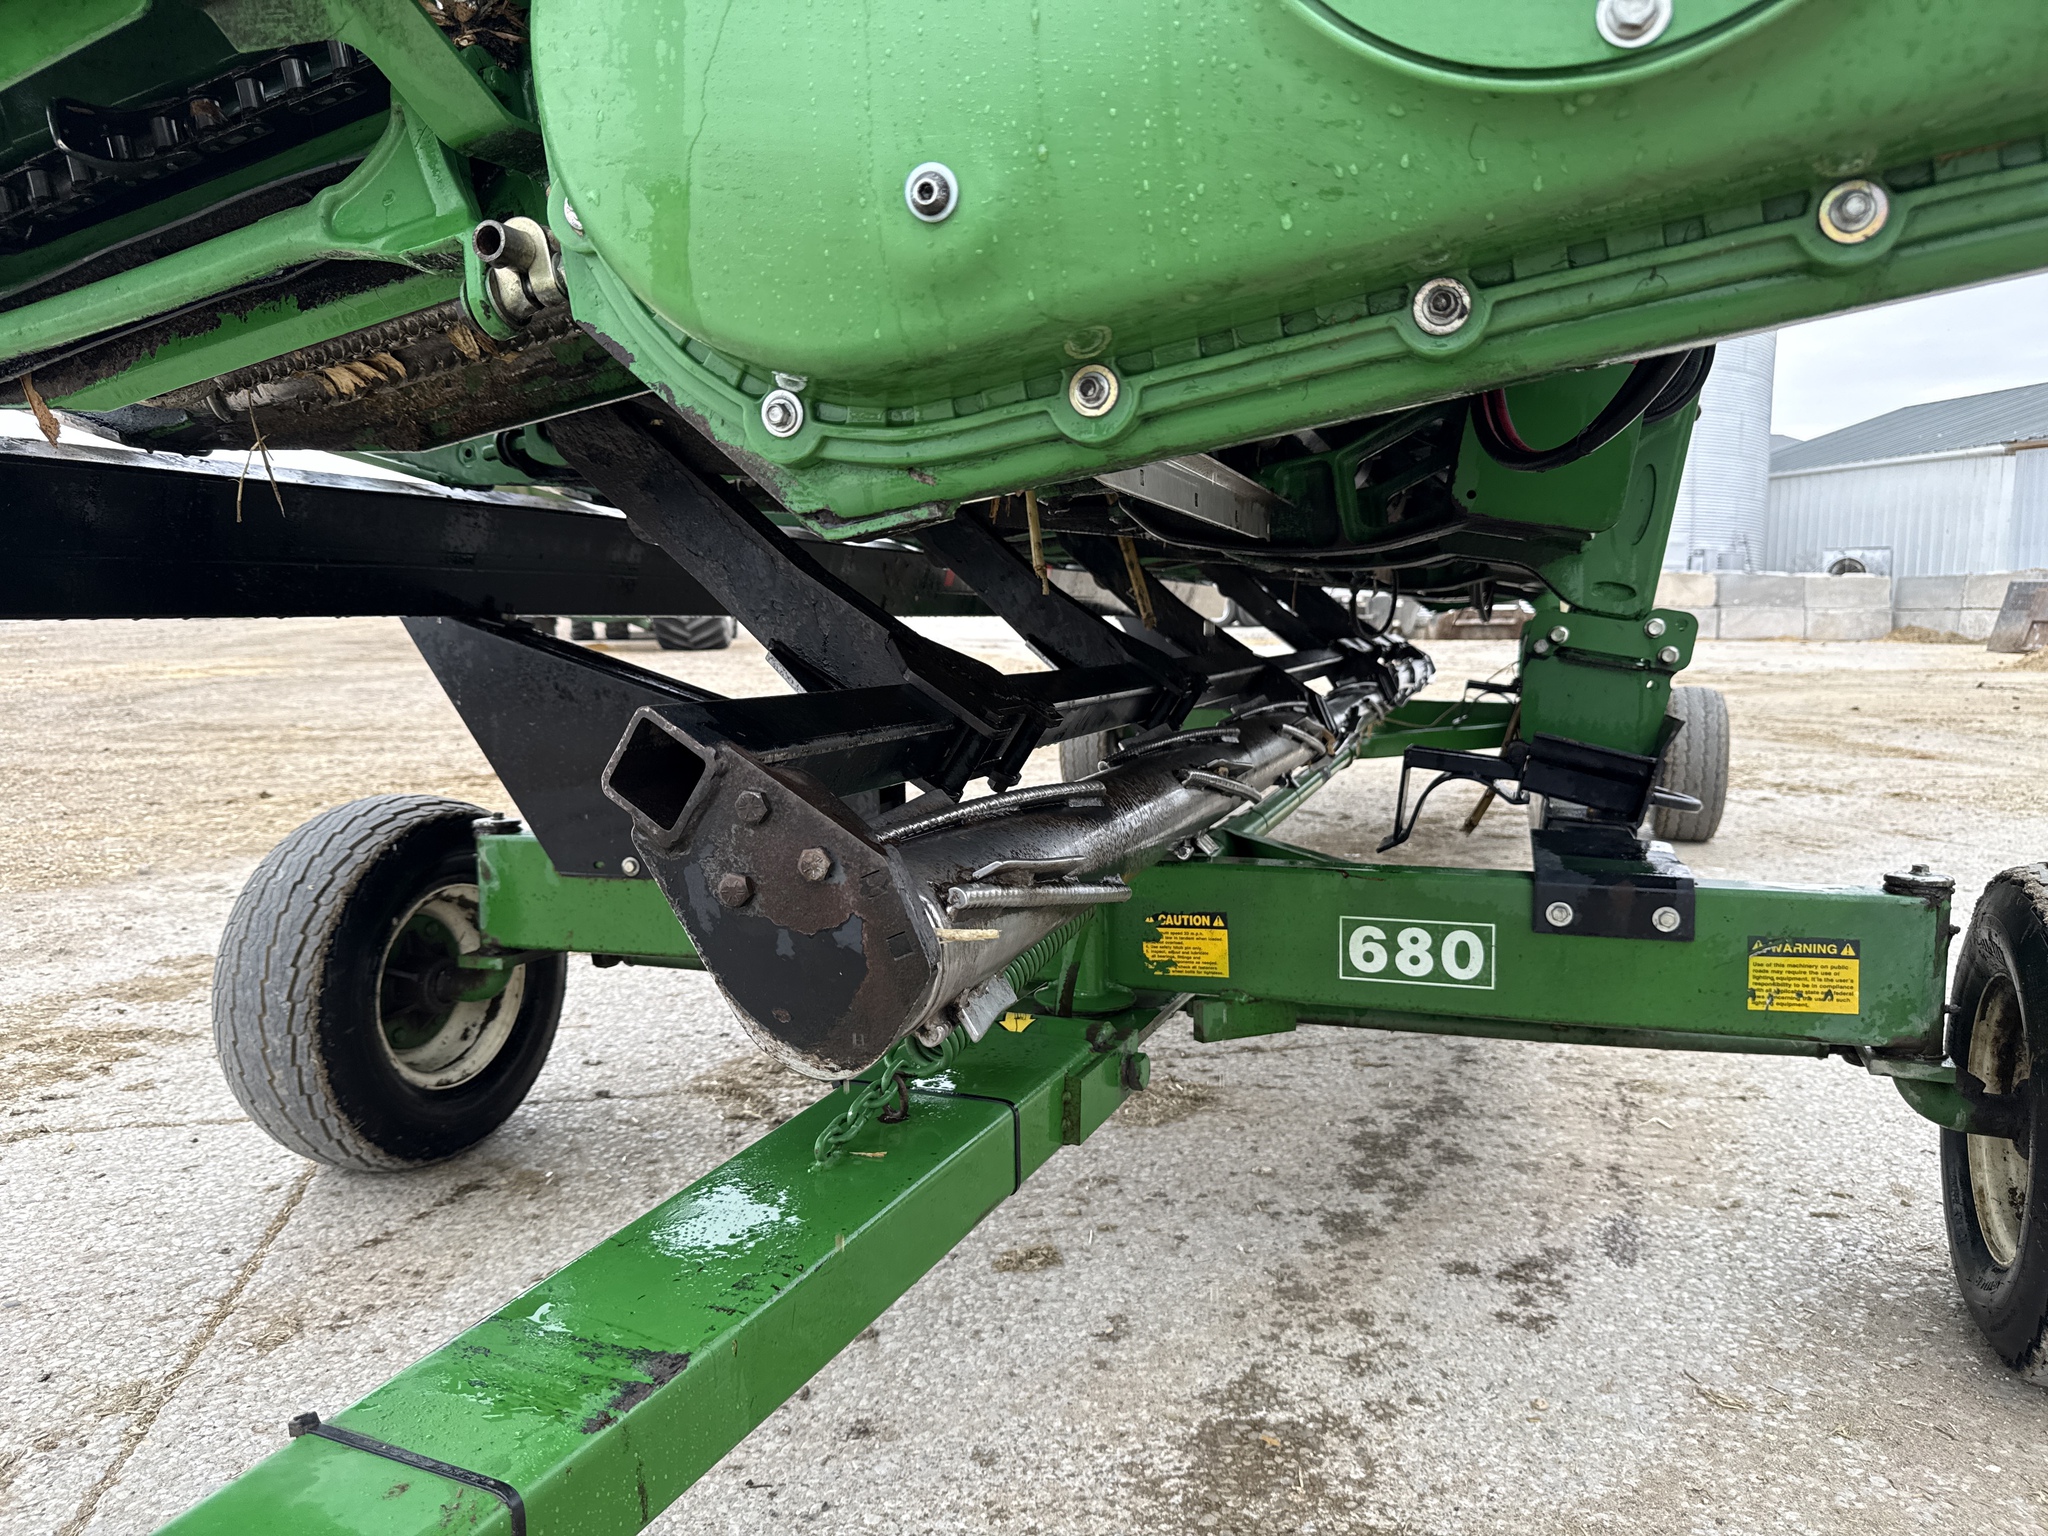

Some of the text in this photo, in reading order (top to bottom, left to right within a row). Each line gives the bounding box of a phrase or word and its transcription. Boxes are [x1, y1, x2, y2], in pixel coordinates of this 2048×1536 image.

[1158, 914, 1210, 926] CAUTION
[1349, 925, 1484, 980] 680
[1771, 944, 1837, 954] WARNING
